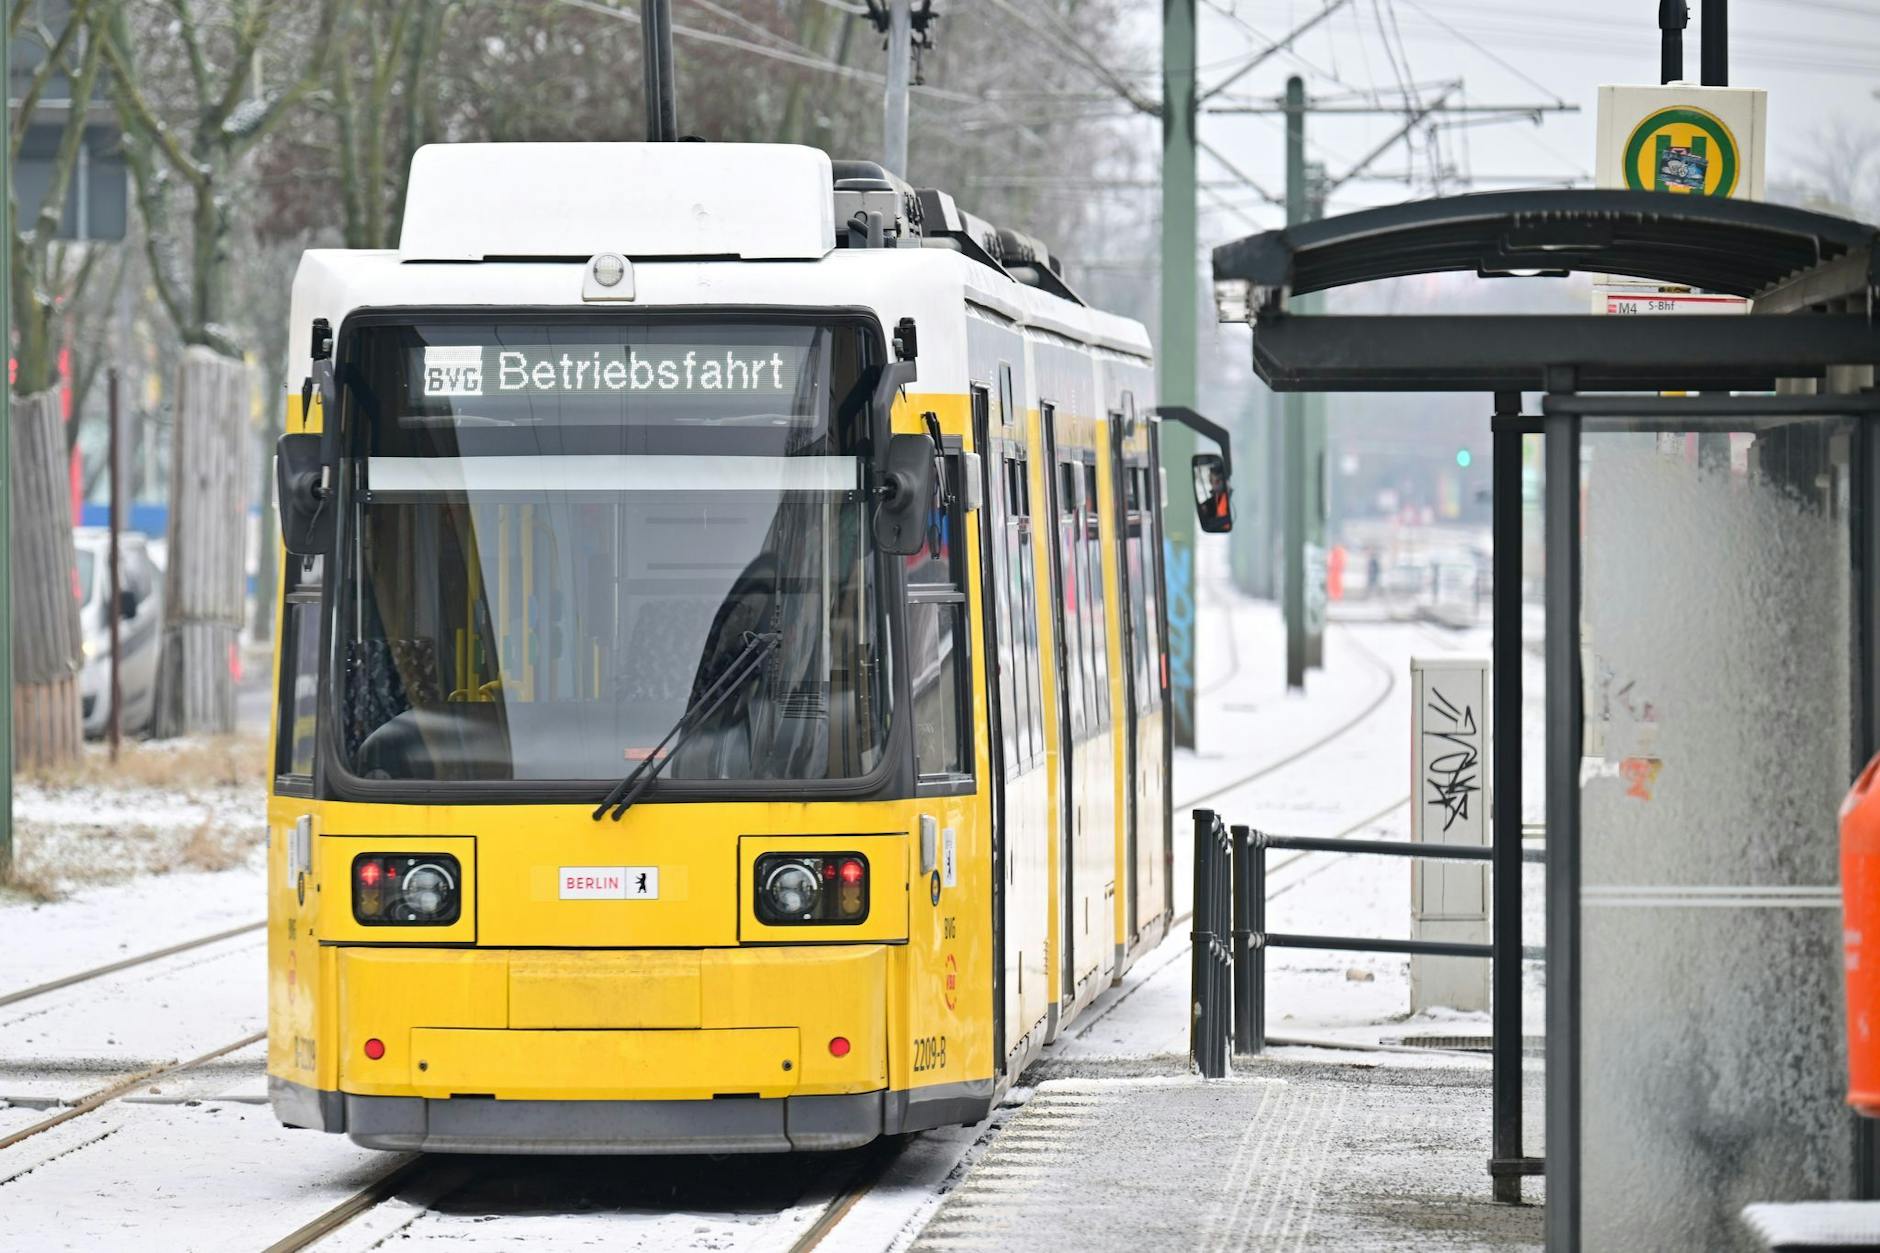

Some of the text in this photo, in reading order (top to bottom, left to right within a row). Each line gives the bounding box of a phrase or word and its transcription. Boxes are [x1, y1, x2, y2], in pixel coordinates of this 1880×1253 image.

[1619, 301, 1675, 314] M4 S-Bhf
[427, 351, 784, 392] BVG Betriebsfahrt
[566, 877, 619, 889] BERLIN
[913, 1035, 946, 1072] 2209-B
